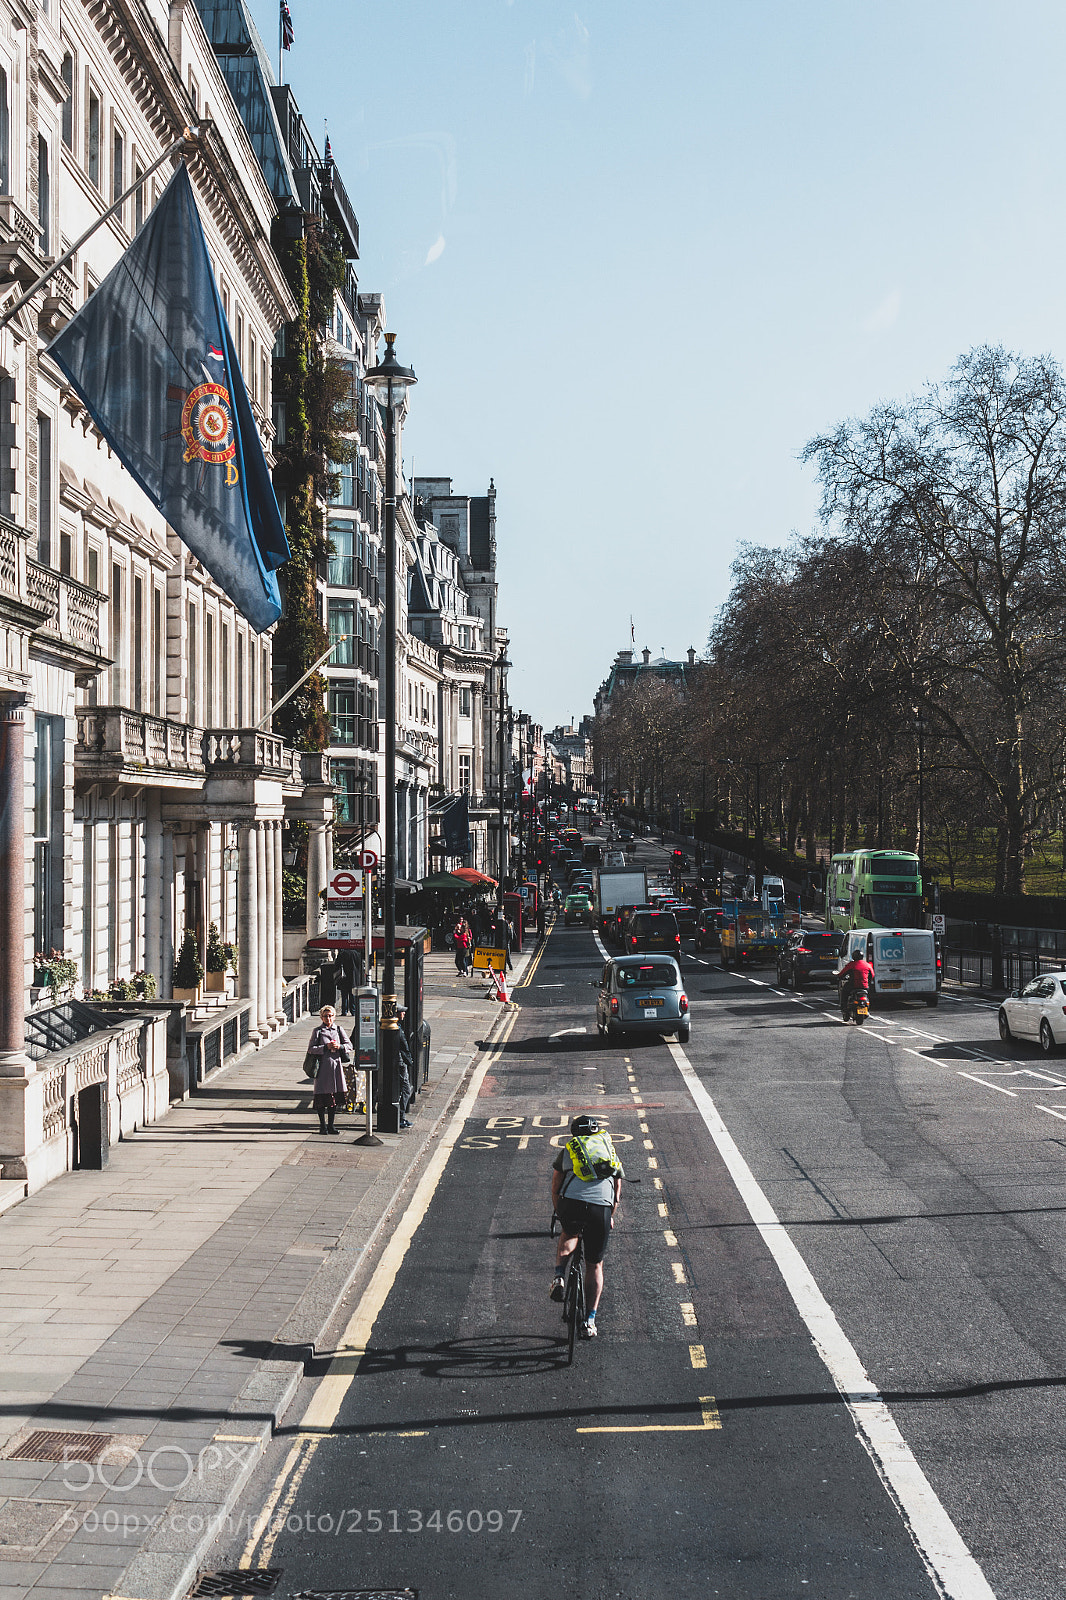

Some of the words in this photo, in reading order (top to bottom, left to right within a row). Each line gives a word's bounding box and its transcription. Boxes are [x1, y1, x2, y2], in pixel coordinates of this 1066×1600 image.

[184, 385, 209, 425] CAVALRY
[211, 450, 233, 461] CLUB
[363, 852, 375, 867] D
[476, 950, 504, 958] Diversion
